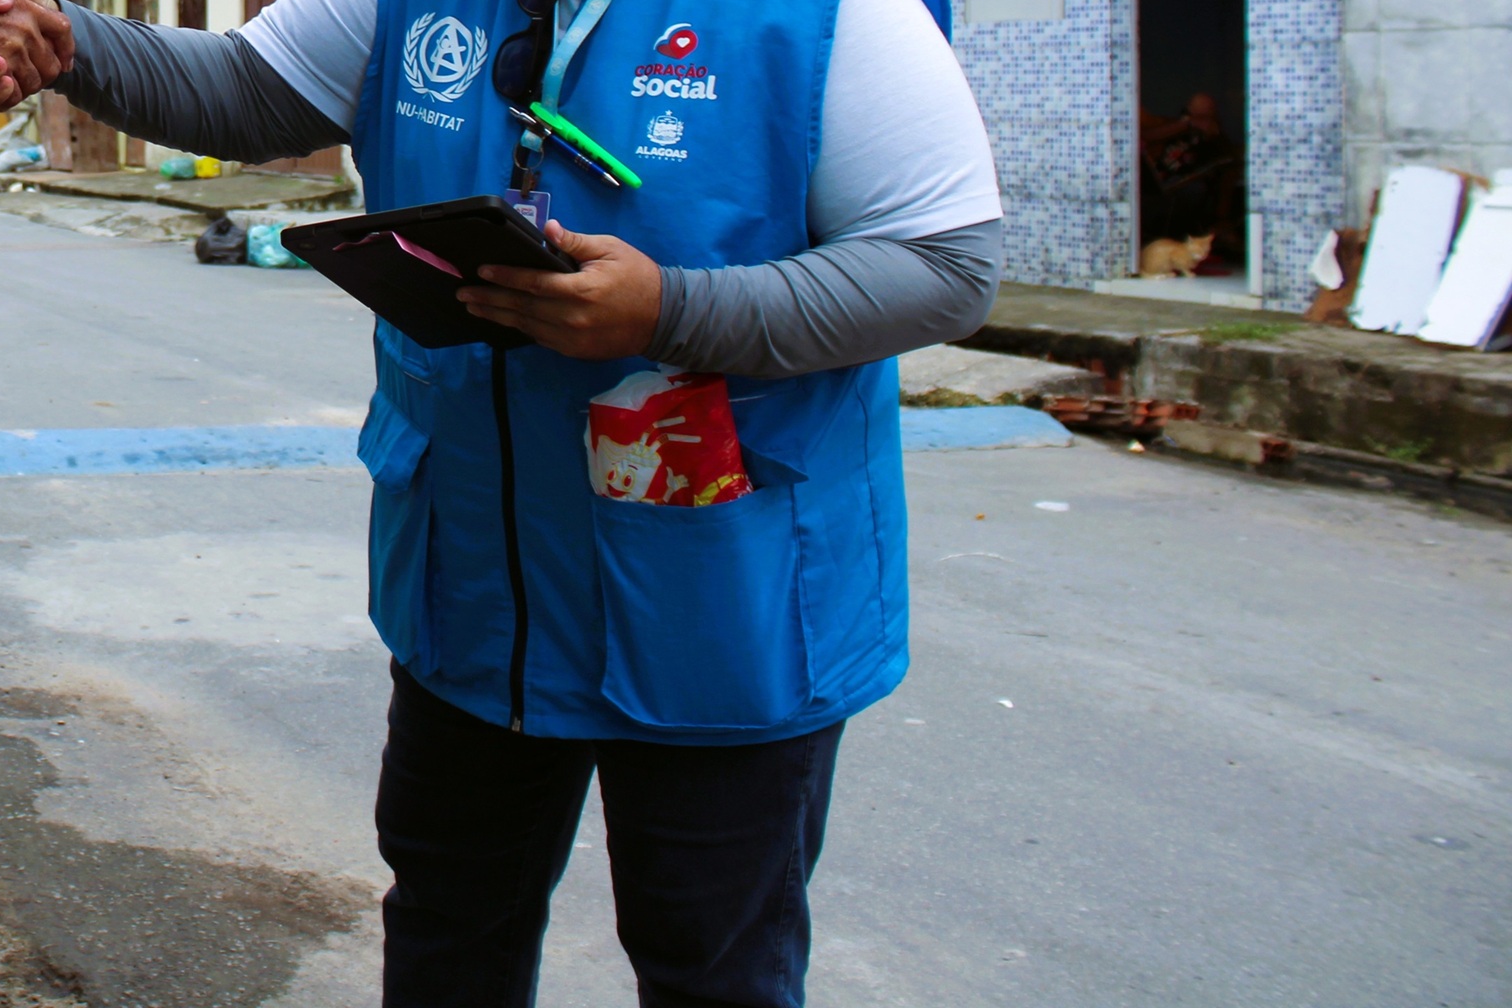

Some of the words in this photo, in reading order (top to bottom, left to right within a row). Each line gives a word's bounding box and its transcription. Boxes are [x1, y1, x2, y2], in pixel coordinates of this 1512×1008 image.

[635, 63, 708, 80] CORAÇÃO
[631, 75, 718, 100] Social
[396, 99, 465, 132] NU-HABITAT
[635, 145, 688, 159] ALAGOAS
